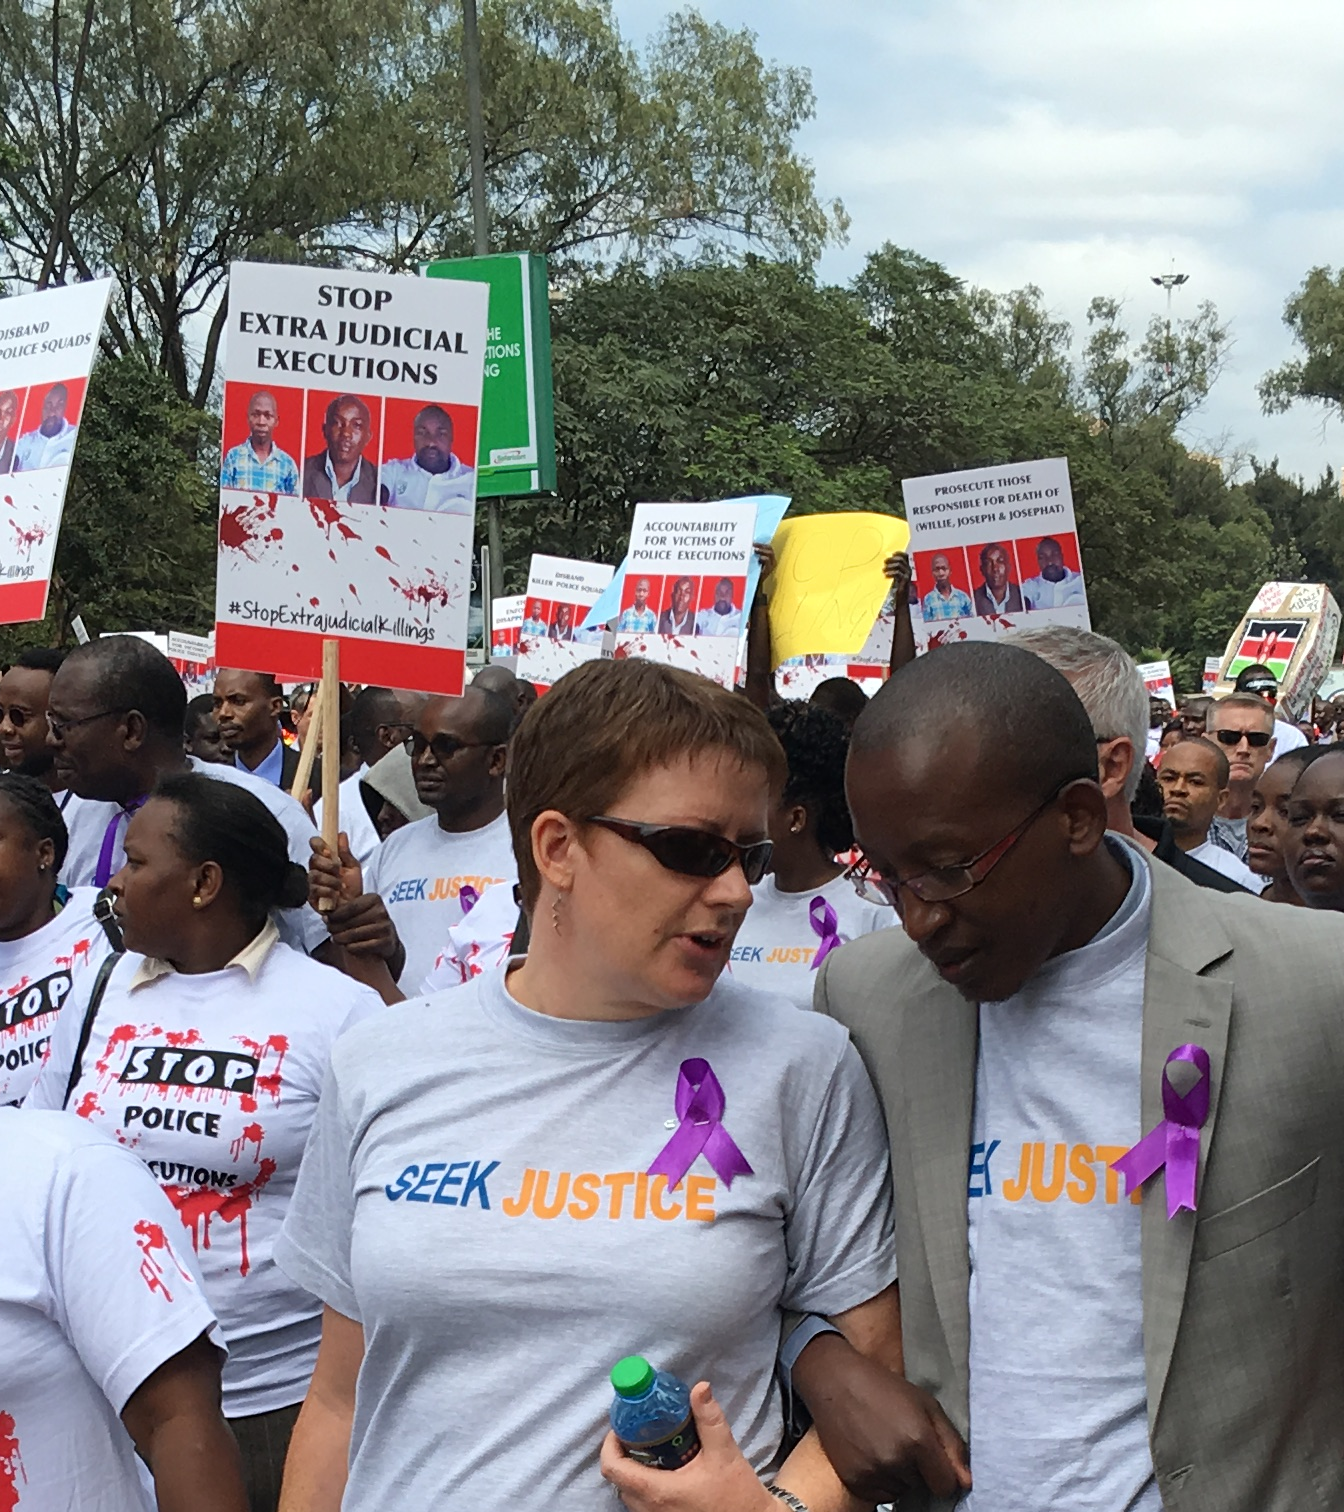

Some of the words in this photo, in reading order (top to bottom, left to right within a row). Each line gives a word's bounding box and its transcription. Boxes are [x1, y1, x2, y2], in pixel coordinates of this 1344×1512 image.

[318, 285, 393, 311] STOP
[40, 333, 92, 353] SQUADS
[239, 312, 328, 341] EXTRA
[335, 321, 469, 354] JUDICIAL
[487, 327, 501, 340] HE
[485, 343, 520, 358] TIONS
[257, 348, 438, 385] EXECUTIONS
[484, 364, 500, 377] NG
[935, 480, 995, 496] PROSECUTE
[997, 475, 1032, 488] THOSE
[913, 498, 980, 515] RESPONSIBLE
[984, 495, 1005, 506] FOR
[1008, 491, 1042, 503] DEATH
[1046, 488, 1060, 497] OF
[644, 522, 737, 532] ACCOUNTABILITY
[916, 518, 955, 532] (WILLIE,
[957, 514, 996, 528] JOSEPH
[999, 512, 1006, 520] &
[1009, 505, 1065, 521] JOSEPHAT)
[645, 536, 667, 546] FOR
[672, 536, 717, 546] VICTIMS
[719, 536, 735, 547] OF
[633, 550, 672, 560] POLICE
[677, 550, 746, 561] EXECUTIONS
[580, 585, 605, 593] SQUAD
[228, 600, 435, 644] #StopExtrajudicialKillings
[389, 878, 428, 904] SEEK
[730, 947, 763, 962] EEK
[766, 947, 817, 964] JUST
[125, 1048, 255, 1089] STOP
[124, 1106, 221, 1138] POLICE
[147, 1159, 238, 1187] CUTIONS
[968, 1140, 1001, 1198] EK
[1002, 1142, 1135, 1205] JUST
[385, 1160, 502, 1210] SEEK
[502, 1168, 718, 1222] JUSTICE
